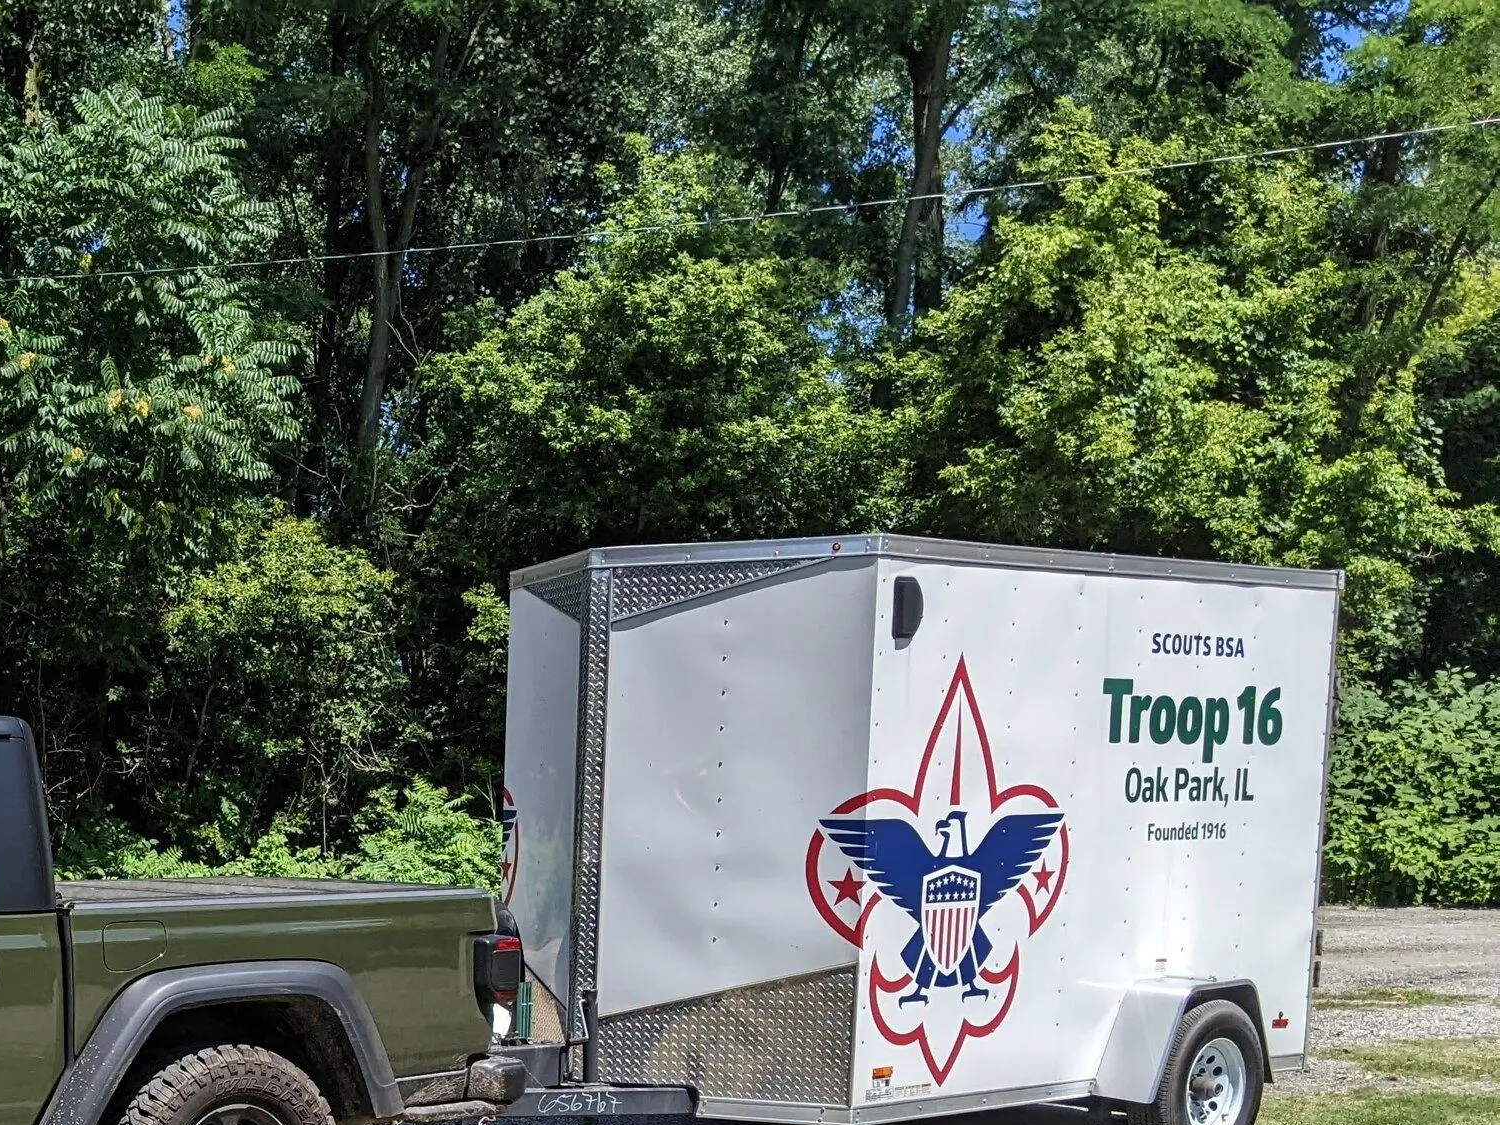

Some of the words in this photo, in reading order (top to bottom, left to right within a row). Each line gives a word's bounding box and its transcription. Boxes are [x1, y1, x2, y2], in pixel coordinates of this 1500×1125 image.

[1151, 633, 1211, 656] SCOUTS
[1215, 636, 1245, 658] BSA
[1102, 677, 1230, 764] Troop
[1236, 685, 1283, 746] 16
[1124, 766, 1169, 804] Oak
[1173, 766, 1229, 808] Park,
[1233, 767, 1255, 803] IL
[1147, 821, 1199, 842] Founded
[1200, 822, 1227, 840] 1916
[537, 1090, 623, 1114] 656767
